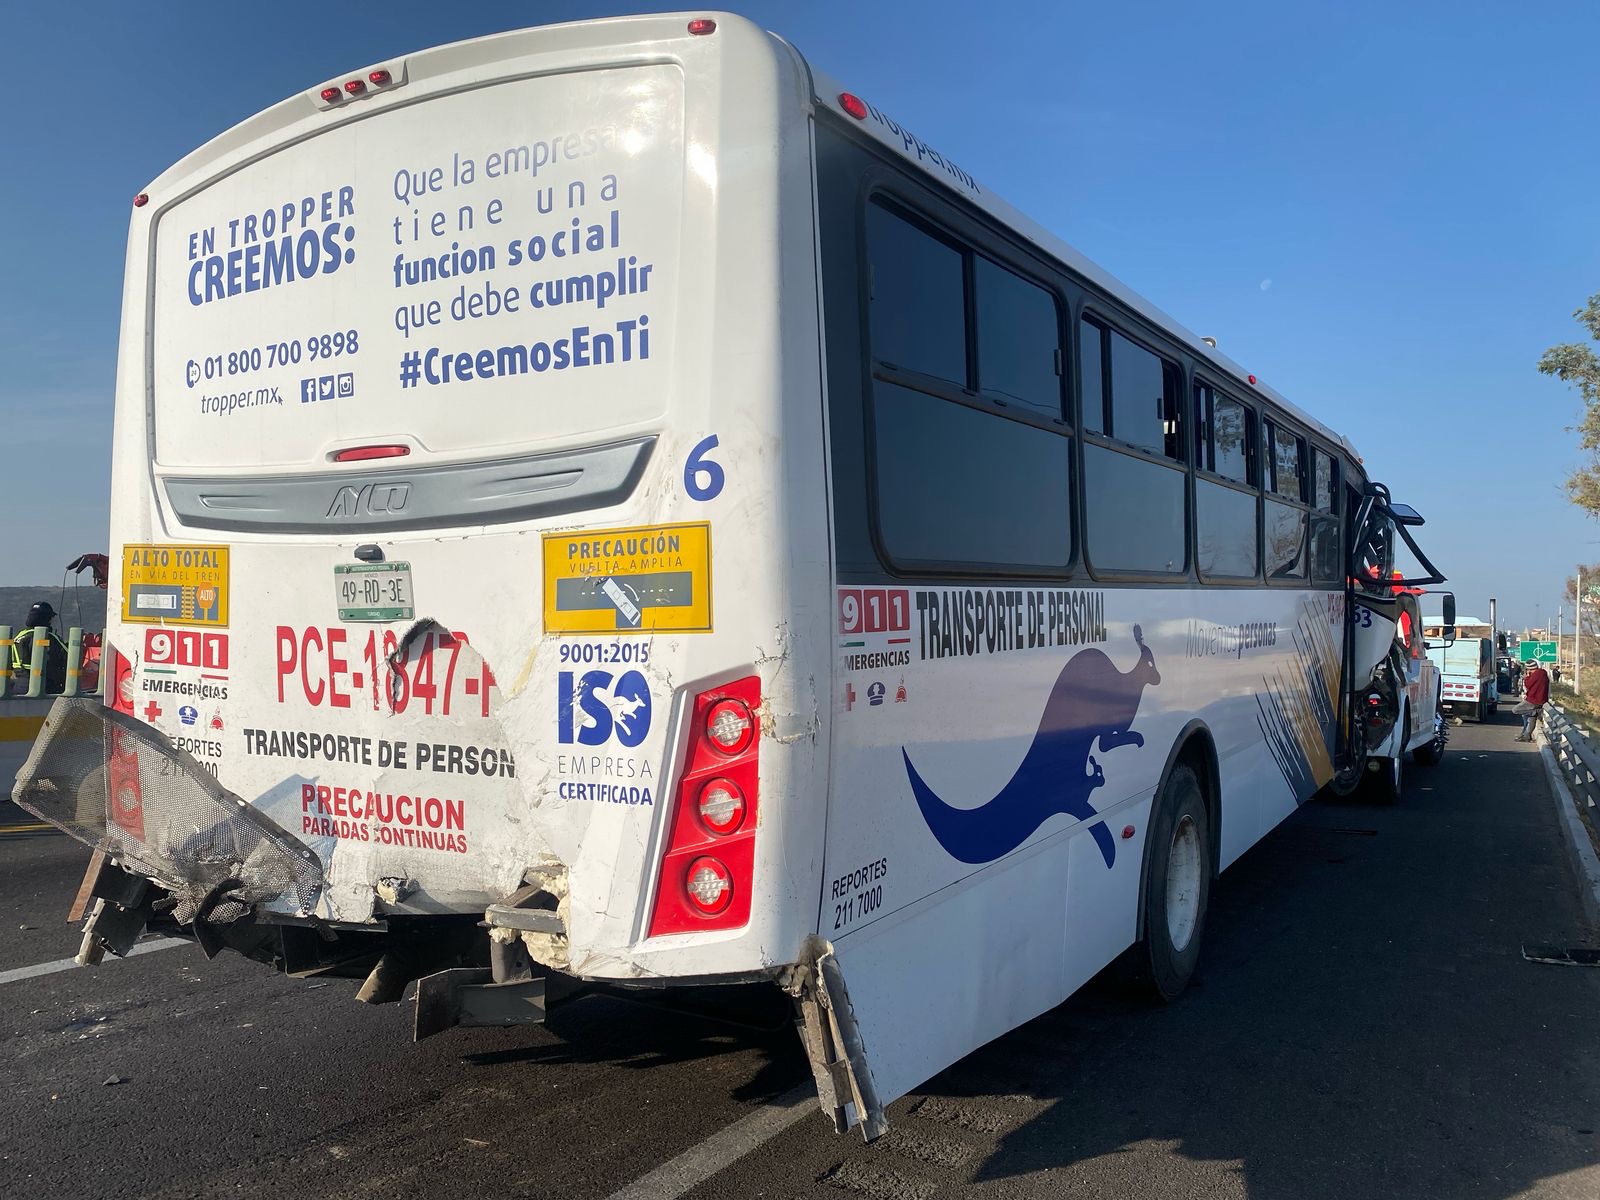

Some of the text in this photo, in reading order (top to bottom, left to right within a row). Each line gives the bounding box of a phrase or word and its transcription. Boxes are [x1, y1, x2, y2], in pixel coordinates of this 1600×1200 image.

[393, 124, 617, 205] Que la empresa
[188, 185, 355, 261] EN TROPPER
[393, 174, 618, 245] tiene una
[187, 222, 356, 306] CREEMOS:
[393, 210, 619, 288] funcion social
[395, 255, 653, 338] que debe cumplir
[204, 329, 360, 380] 01 800 700 9898
[399, 314, 650, 389] #CreemosEnTi
[201, 386, 280, 417] tropper.mx
[683, 433, 725, 502] 6
[131, 550, 219, 569] ALTO TOTAL
[568, 531, 680, 560] PRECAUCIÓN
[569, 556, 683, 574] VUELTA AMPLIA
[130, 570, 141, 579] EN
[172, 571, 190, 580] DEL
[196, 571, 220, 581] TREN
[200, 589, 214, 601] ALTO
[342, 578, 406, 603] 49-RD-3E
[842, 594, 903, 631] 911
[915, 589, 1107, 660] TRANSPORTE DE PERSONAL
[151, 633, 220, 666] 911
[559, 642, 649, 663] 9001:2015
[842, 650, 910, 671] MERGENCIAS
[142, 678, 228, 700] EMERGENCIAS
[558, 669, 652, 748] ISO
[243, 728, 373, 766] TRANSPORTE
[377, 739, 408, 770] DE
[558, 755, 653, 778] EMPRESA
[301, 783, 465, 831] PRECAUCION
[558, 781, 654, 806] CERTIFICADA
[302, 816, 370, 842] PARADAS
[831, 857, 887, 901] REPORTES
[834, 884, 883, 930] 211 7000
